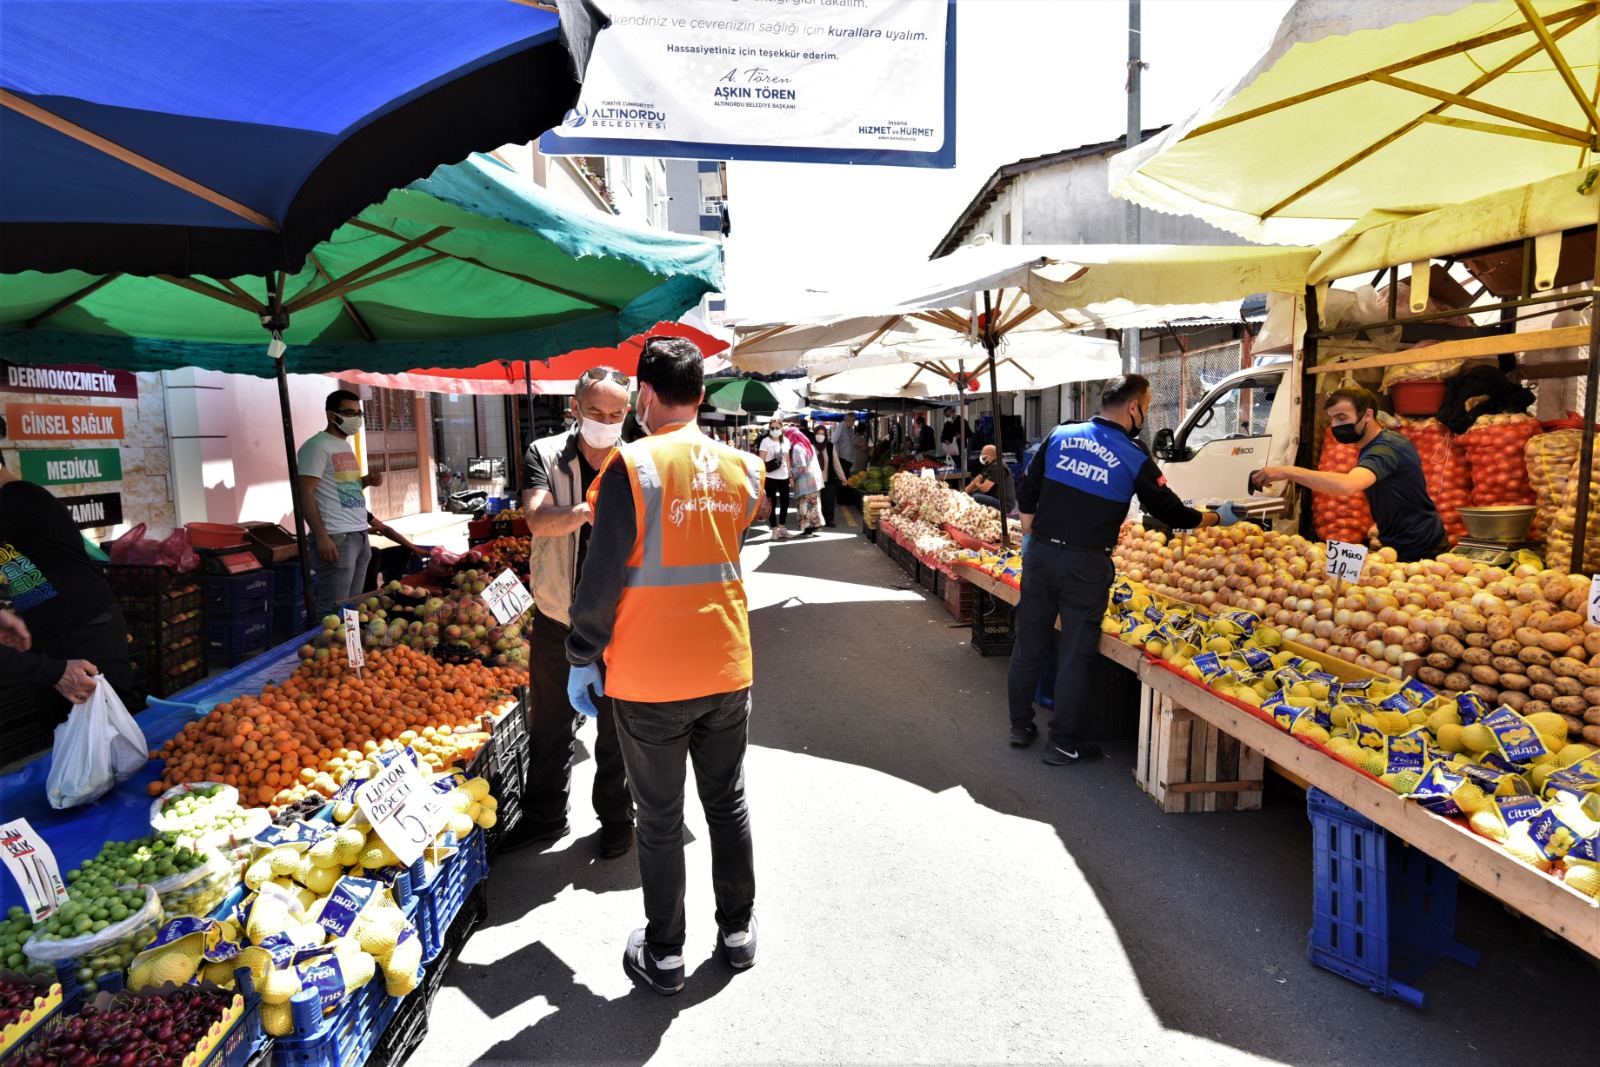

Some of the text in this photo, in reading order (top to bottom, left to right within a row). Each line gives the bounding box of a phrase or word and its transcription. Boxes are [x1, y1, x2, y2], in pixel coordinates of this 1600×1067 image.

[613, 14, 928, 42] kendiniz ve çevrenizin sağlığı için kurallara uyalım.
[666, 44, 839, 60] Hassasiyetiniz için teşekkür ederim.
[714, 86, 796, 101] AŞKIN TÖREN
[592, 108, 666, 121] ALTINORDU
[8, 366, 117, 393] DERMOKOZMETİK
[21, 410, 115, 435] CİNSEL SAĞLIK
[1060, 437, 1121, 468] ALTINORDU
[46, 456, 103, 480] MEDİKAL
[1056, 454, 1109, 485] ZABITA
[66, 499, 105, 523] AMİN
[1326, 540, 1340, 560] 5
[1200, 663, 1218, 671] Citrus
[1510, 745, 1539, 757] Citrus
[1508, 807, 1540, 819] Citrus
[1535, 816, 1552, 840] Fresh
[333, 894, 359, 913] Citrus
[165, 920, 183, 942] Citrus
[320, 916, 345, 933] Fresh
[307, 965, 336, 982] Fresh
[320, 990, 342, 1004] trus
